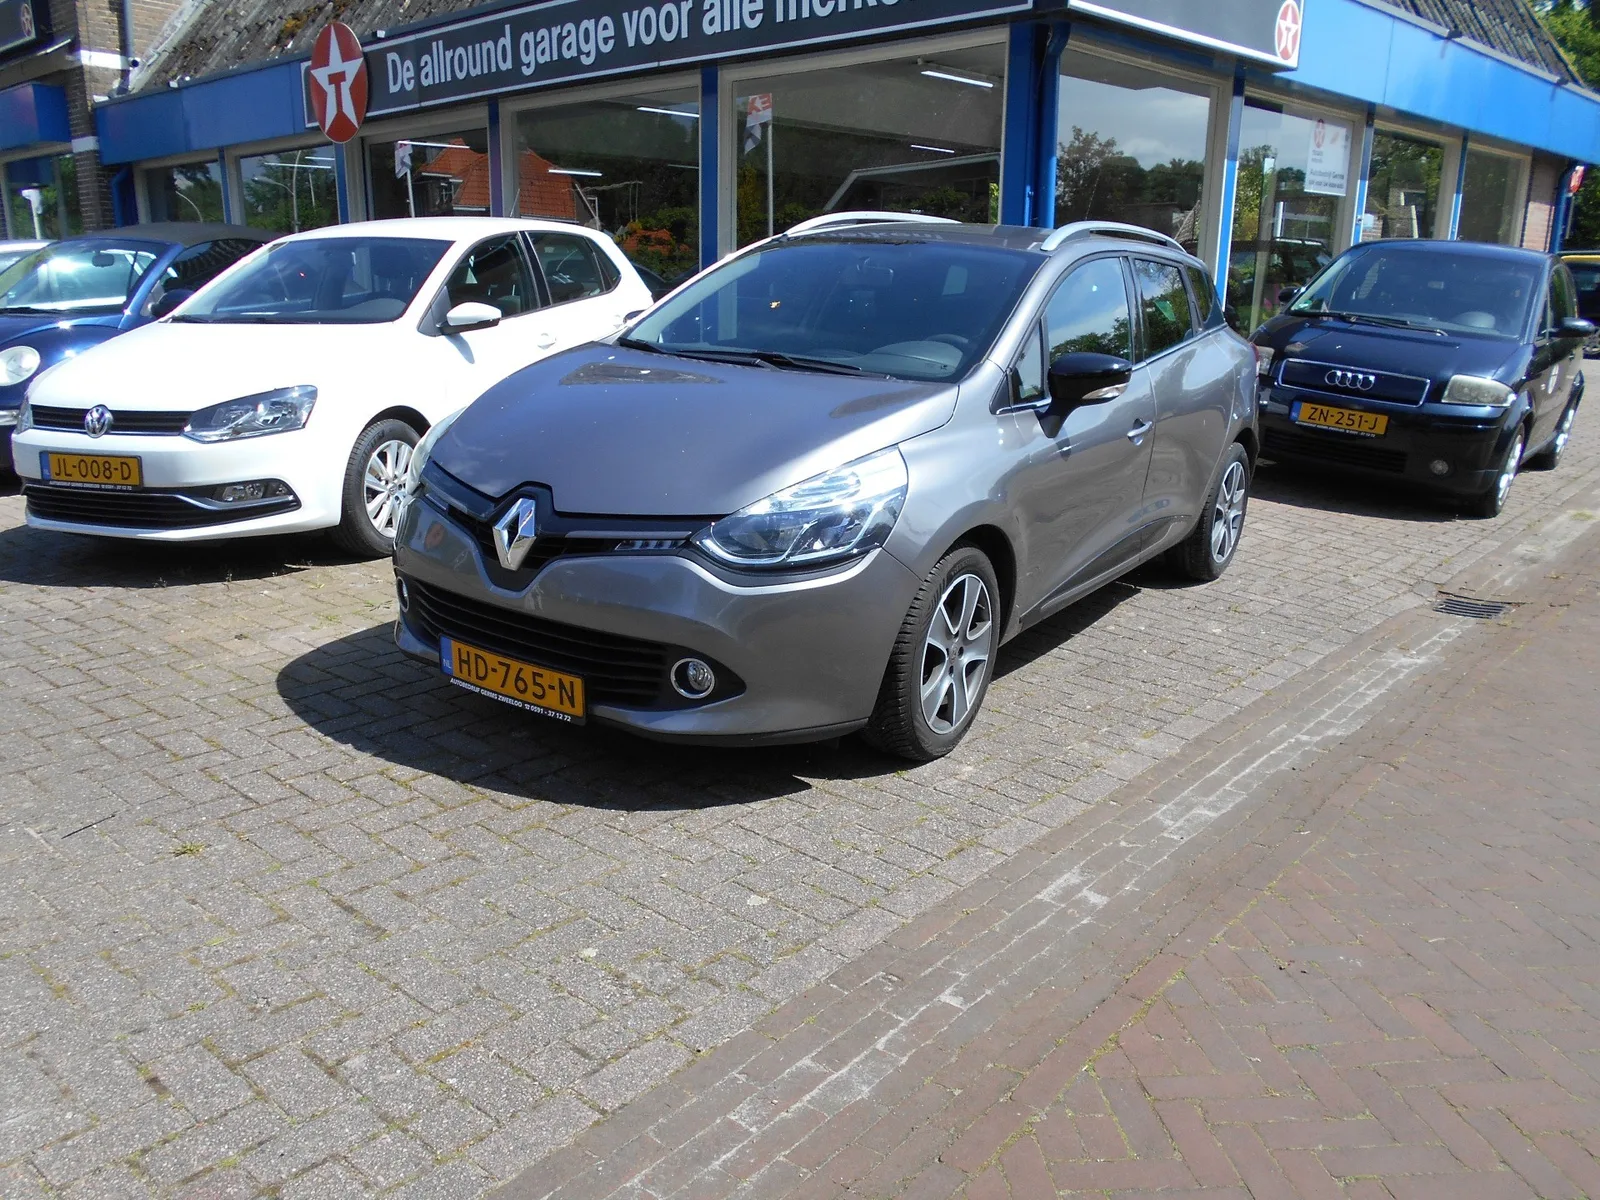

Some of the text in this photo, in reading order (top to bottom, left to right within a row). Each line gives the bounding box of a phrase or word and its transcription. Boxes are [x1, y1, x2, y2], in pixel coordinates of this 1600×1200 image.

[387, 52, 414, 93] De
[420, 24, 512, 87] allround
[520, 15, 615, 76] garage
[622, 0, 692, 48] voor
[701, 0, 764, 35] alle
[1308, 407, 1378, 430] ZN-251-J
[55, 458, 132, 480] JL-008-D
[443, 658, 451, 669] NL
[457, 647, 576, 708] HD-765-N
[450, 677, 480, 693] AUTOBEDRIJF
[498, 695, 523, 708] ZWEELOO
